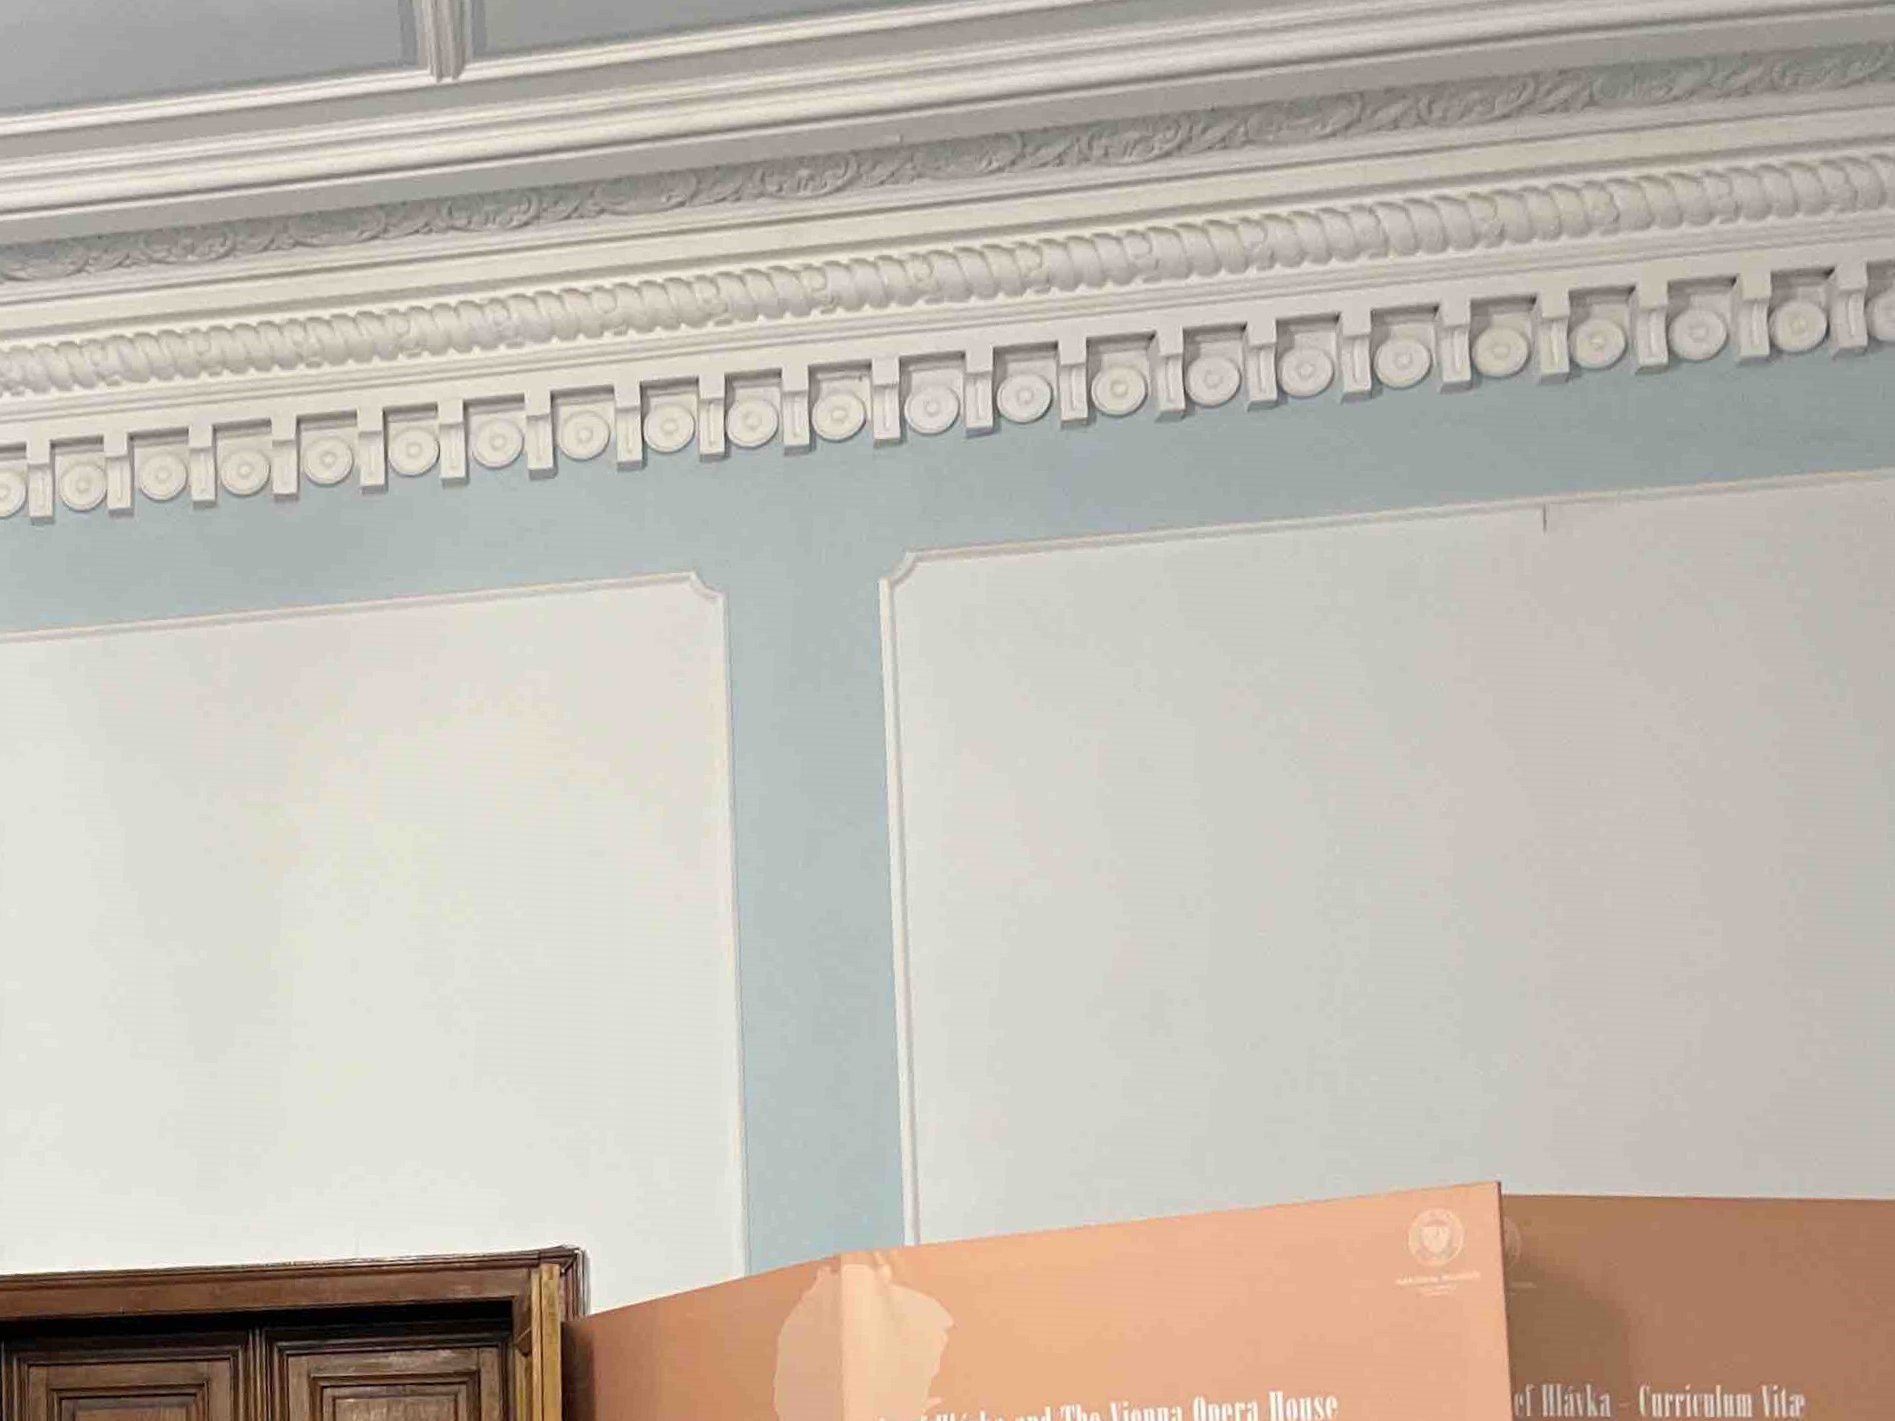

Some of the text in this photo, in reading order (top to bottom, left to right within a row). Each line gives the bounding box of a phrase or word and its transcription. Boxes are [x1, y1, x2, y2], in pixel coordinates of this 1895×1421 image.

[1542, 1383, 1611, 1418] Hlávka
[1638, 1383, 1753, 1418] Curriculum
[1761, 1383, 1806, 1419] Vitæ
